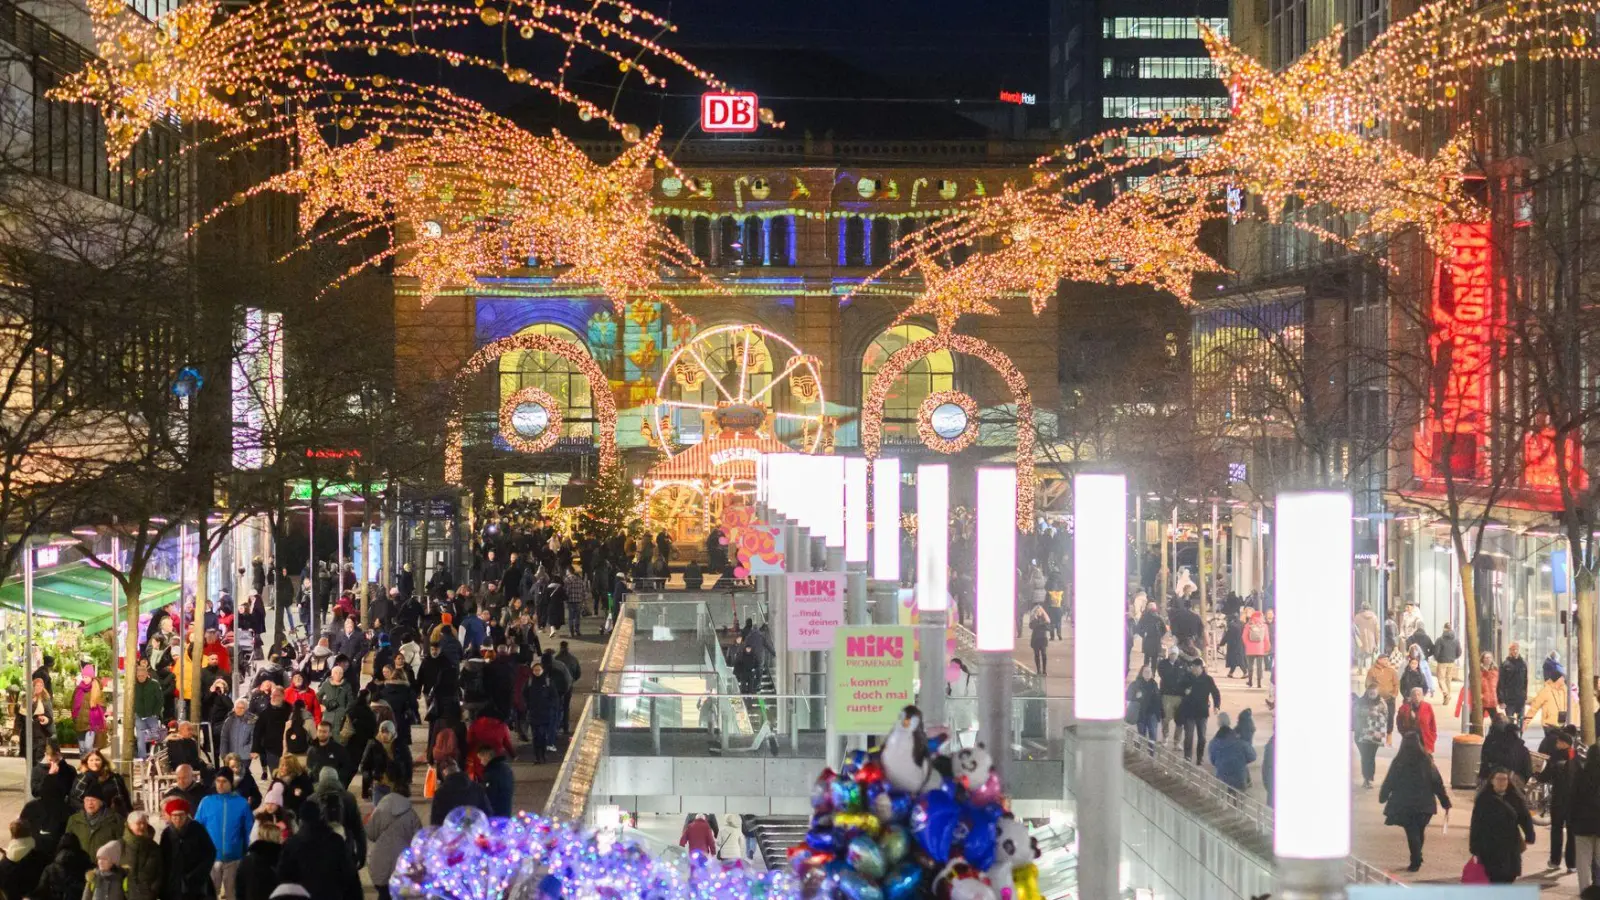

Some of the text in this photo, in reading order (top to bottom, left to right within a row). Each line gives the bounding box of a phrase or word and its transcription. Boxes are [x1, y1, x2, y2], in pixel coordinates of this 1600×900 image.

[709, 99, 751, 125] DB
[808, 618, 839, 627] deinen
[798, 627, 821, 637] Style
[846, 659, 904, 668] PROMENADE
[853, 690, 908, 700] doch mal
[846, 704, 884, 713] runter
